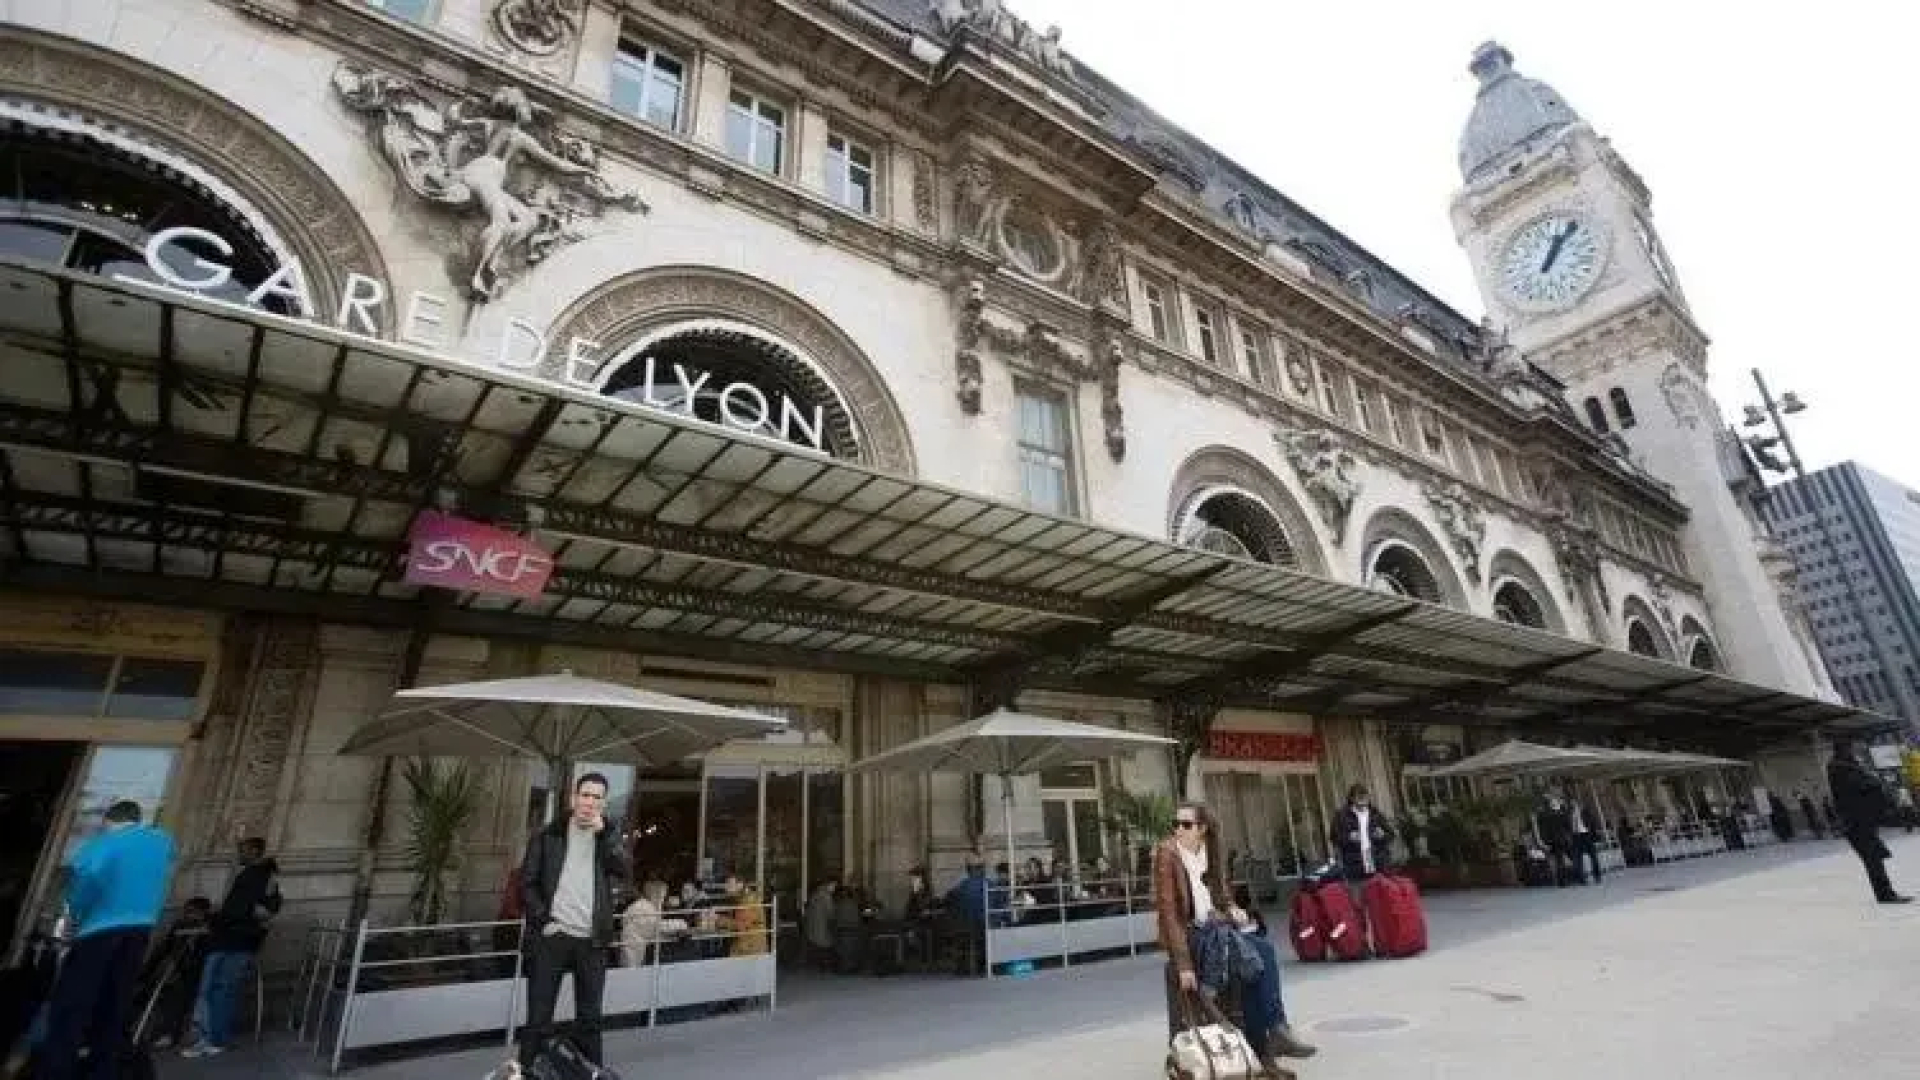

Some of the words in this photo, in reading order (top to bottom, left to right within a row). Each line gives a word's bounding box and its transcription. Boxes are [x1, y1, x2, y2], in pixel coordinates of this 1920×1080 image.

[147, 226, 446, 350] GARE
[500, 315, 601, 389] DE
[642, 356, 823, 452] LYON
[417, 539, 554, 583] SNCF
